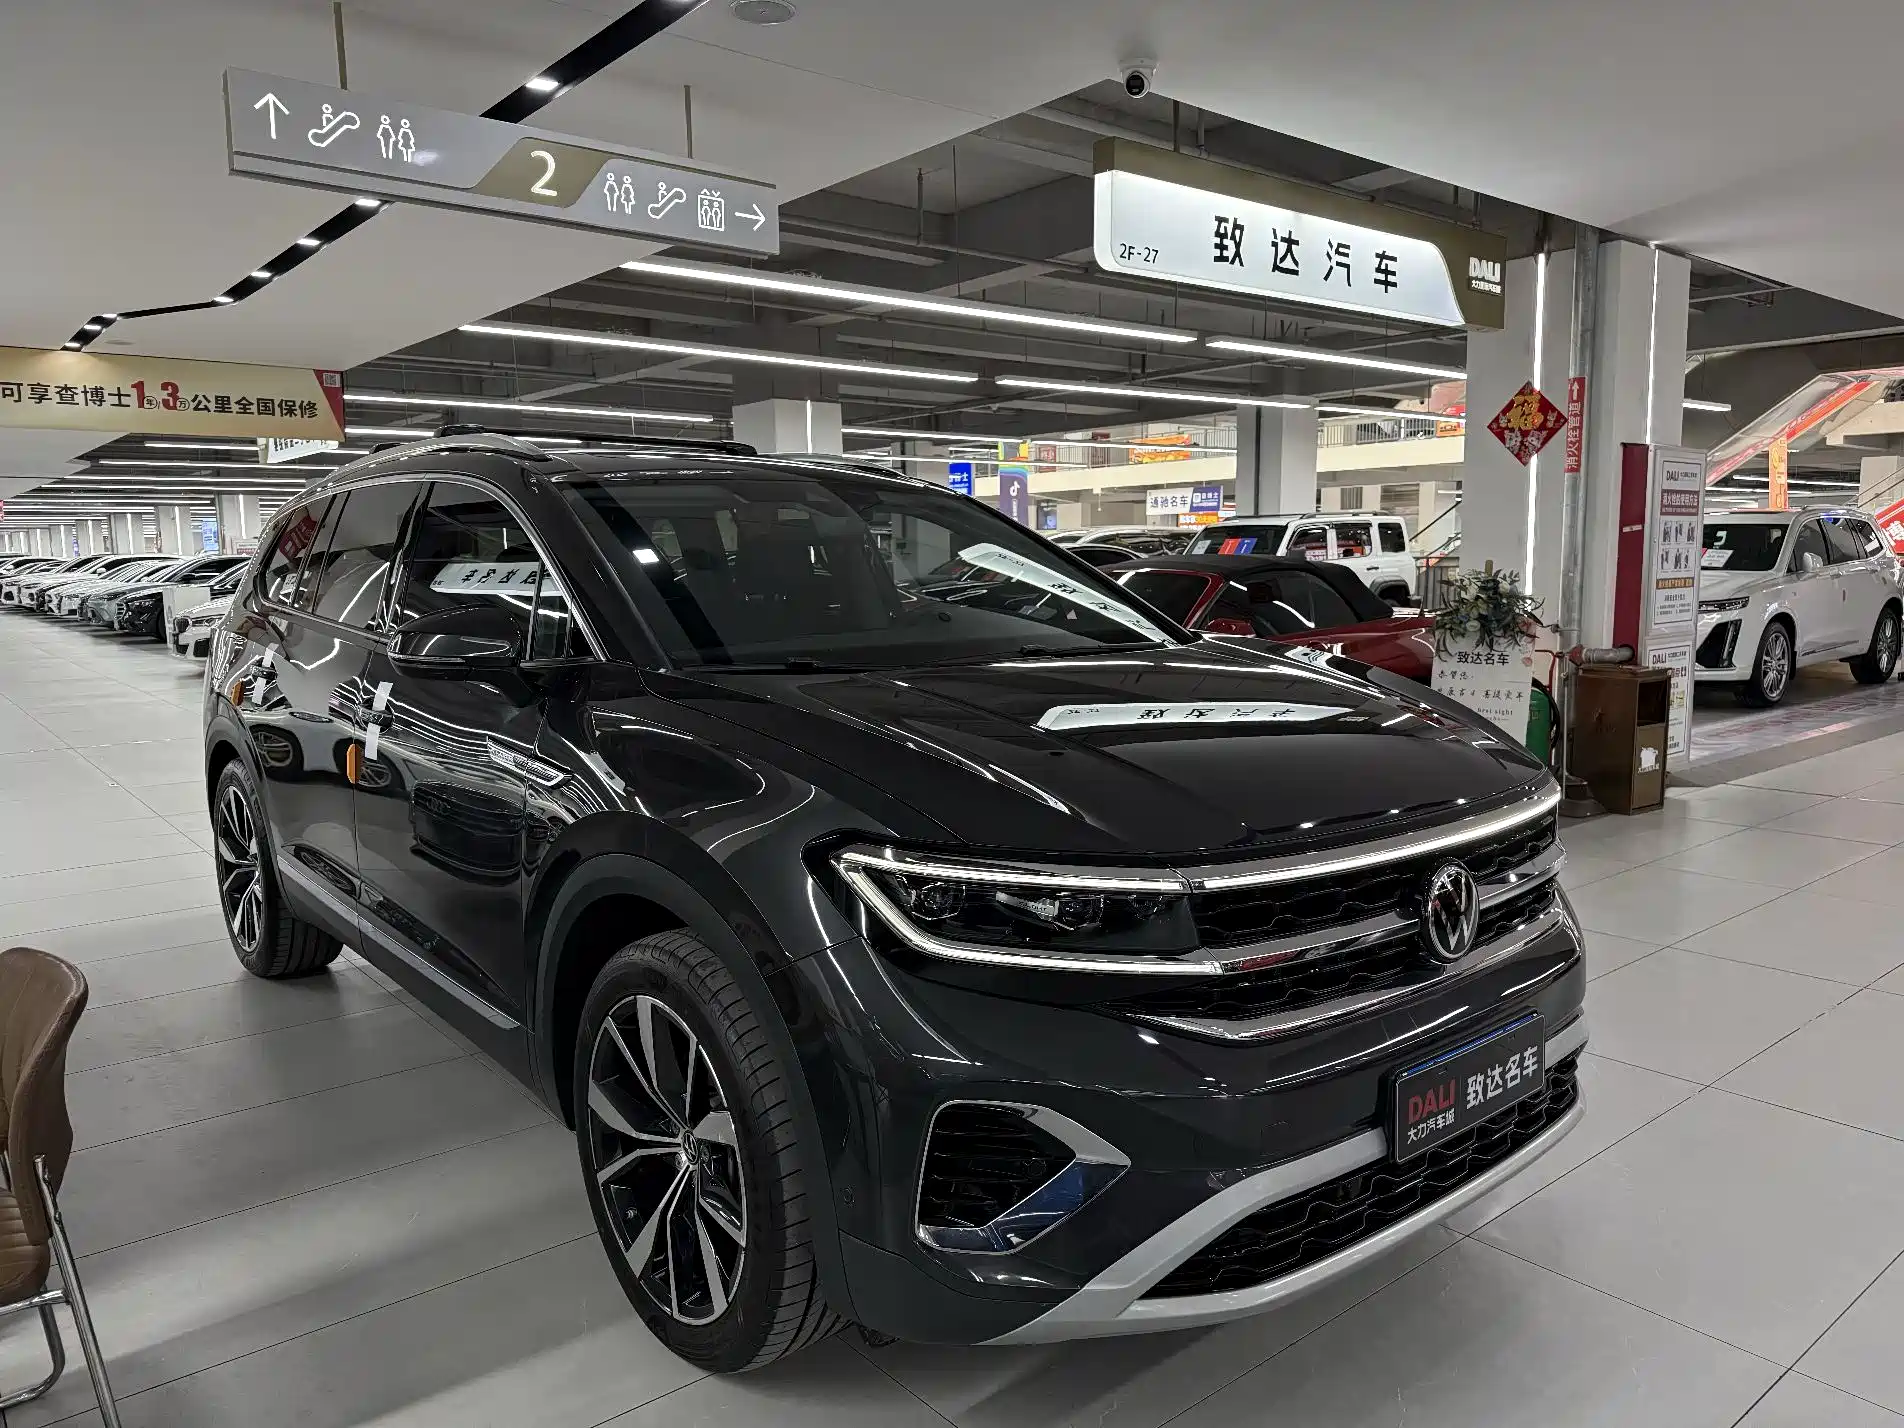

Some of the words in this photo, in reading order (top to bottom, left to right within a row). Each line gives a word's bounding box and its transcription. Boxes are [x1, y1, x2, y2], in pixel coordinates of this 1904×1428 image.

[531, 150, 558, 197] 2
[1119, 242, 1159, 264] 2F-27
[1213, 214, 1398, 294] 致达汽车
[1566, 401, 1581, 469] 消火栓管道
[1456, 651, 1510, 667] 致达名车
[1466, 1045, 1539, 1110] 致达名车
[1408, 1078, 1456, 1125] DALI
